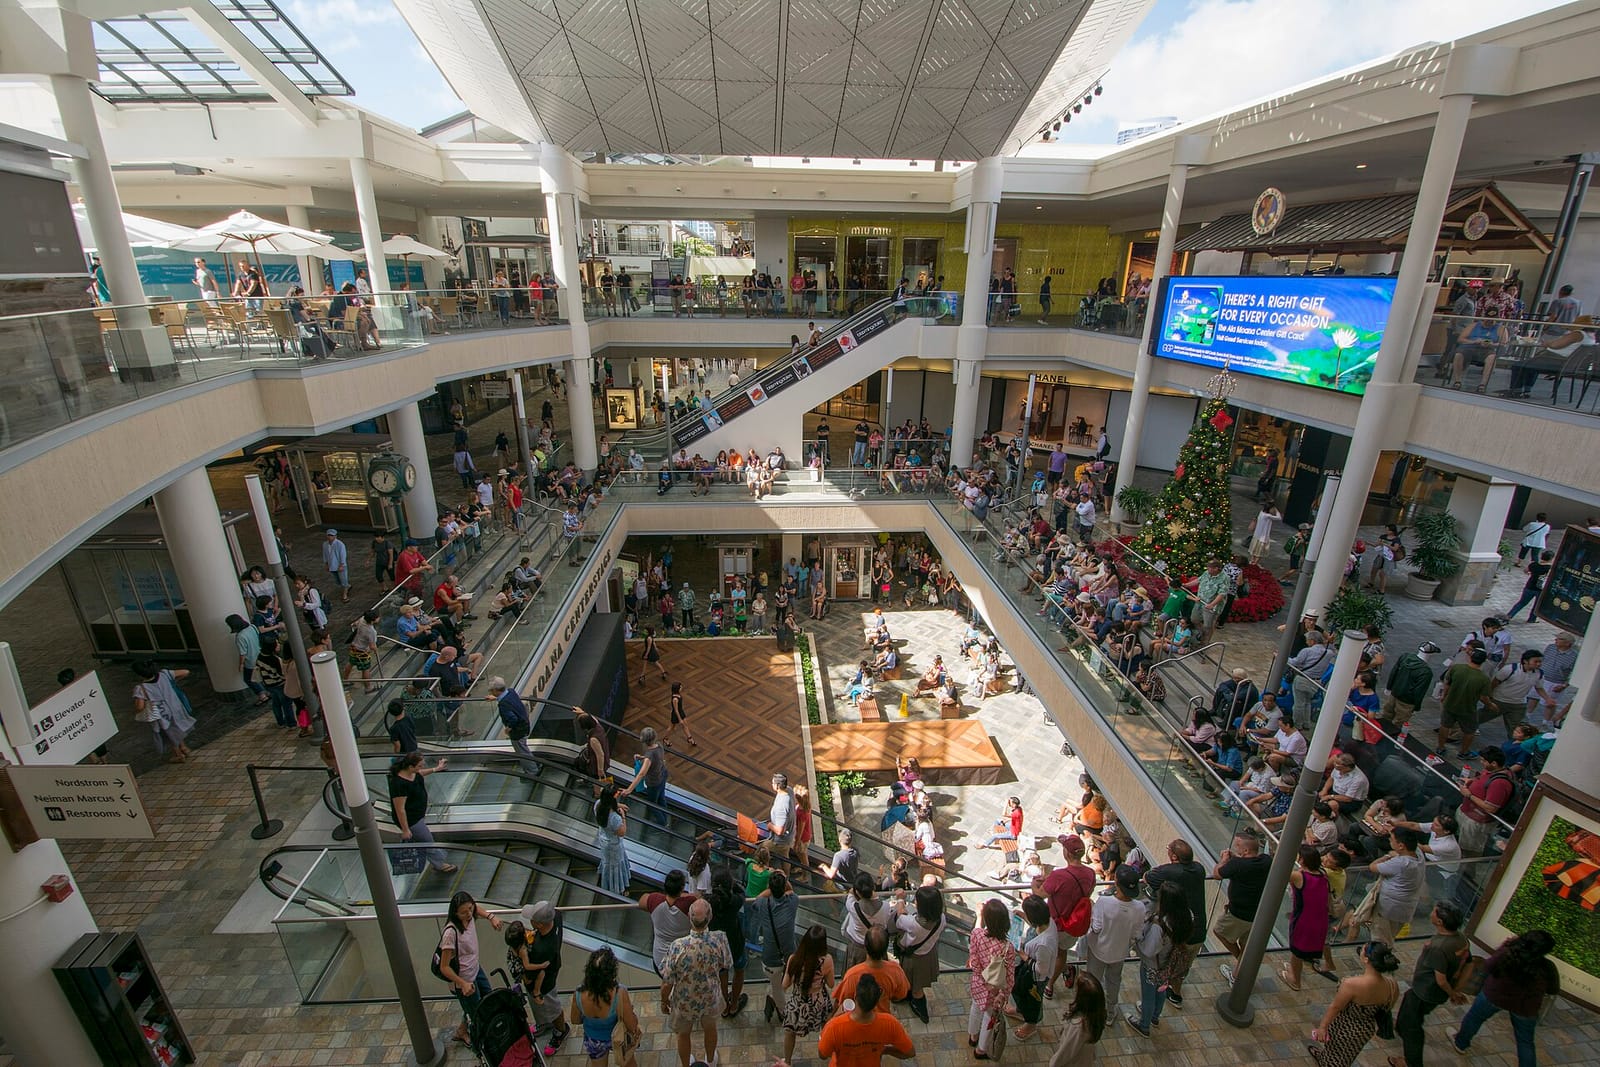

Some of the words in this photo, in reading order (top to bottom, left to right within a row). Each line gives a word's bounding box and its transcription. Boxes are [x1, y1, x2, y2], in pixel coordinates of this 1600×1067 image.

[1224, 294, 1256, 306] THERE'S
[1257, 296, 1264, 307] A
[1268, 296, 1298, 309] RIGHT
[1300, 297, 1325, 310] GIFT
[1221, 309, 1238, 321] FOR
[1239, 310, 1268, 324] EVERY
[1270, 312, 1330, 330] OCCASION.
[1256, 328, 1276, 337] Center
[564, 548, 612, 642] CENTERSTAGE
[54, 697, 86, 722] Elevator
[49, 718, 84, 744] Escalator
[82, 712, 91, 722] to
[68, 724, 88, 741] Level
[55, 779, 108, 787] Nordstrom
[34, 794, 74, 802] Neiman
[77, 794, 115, 803] Marcus
[66, 810, 121, 818] Restrooms
[1561, 974, 1592, 992] ENETA
